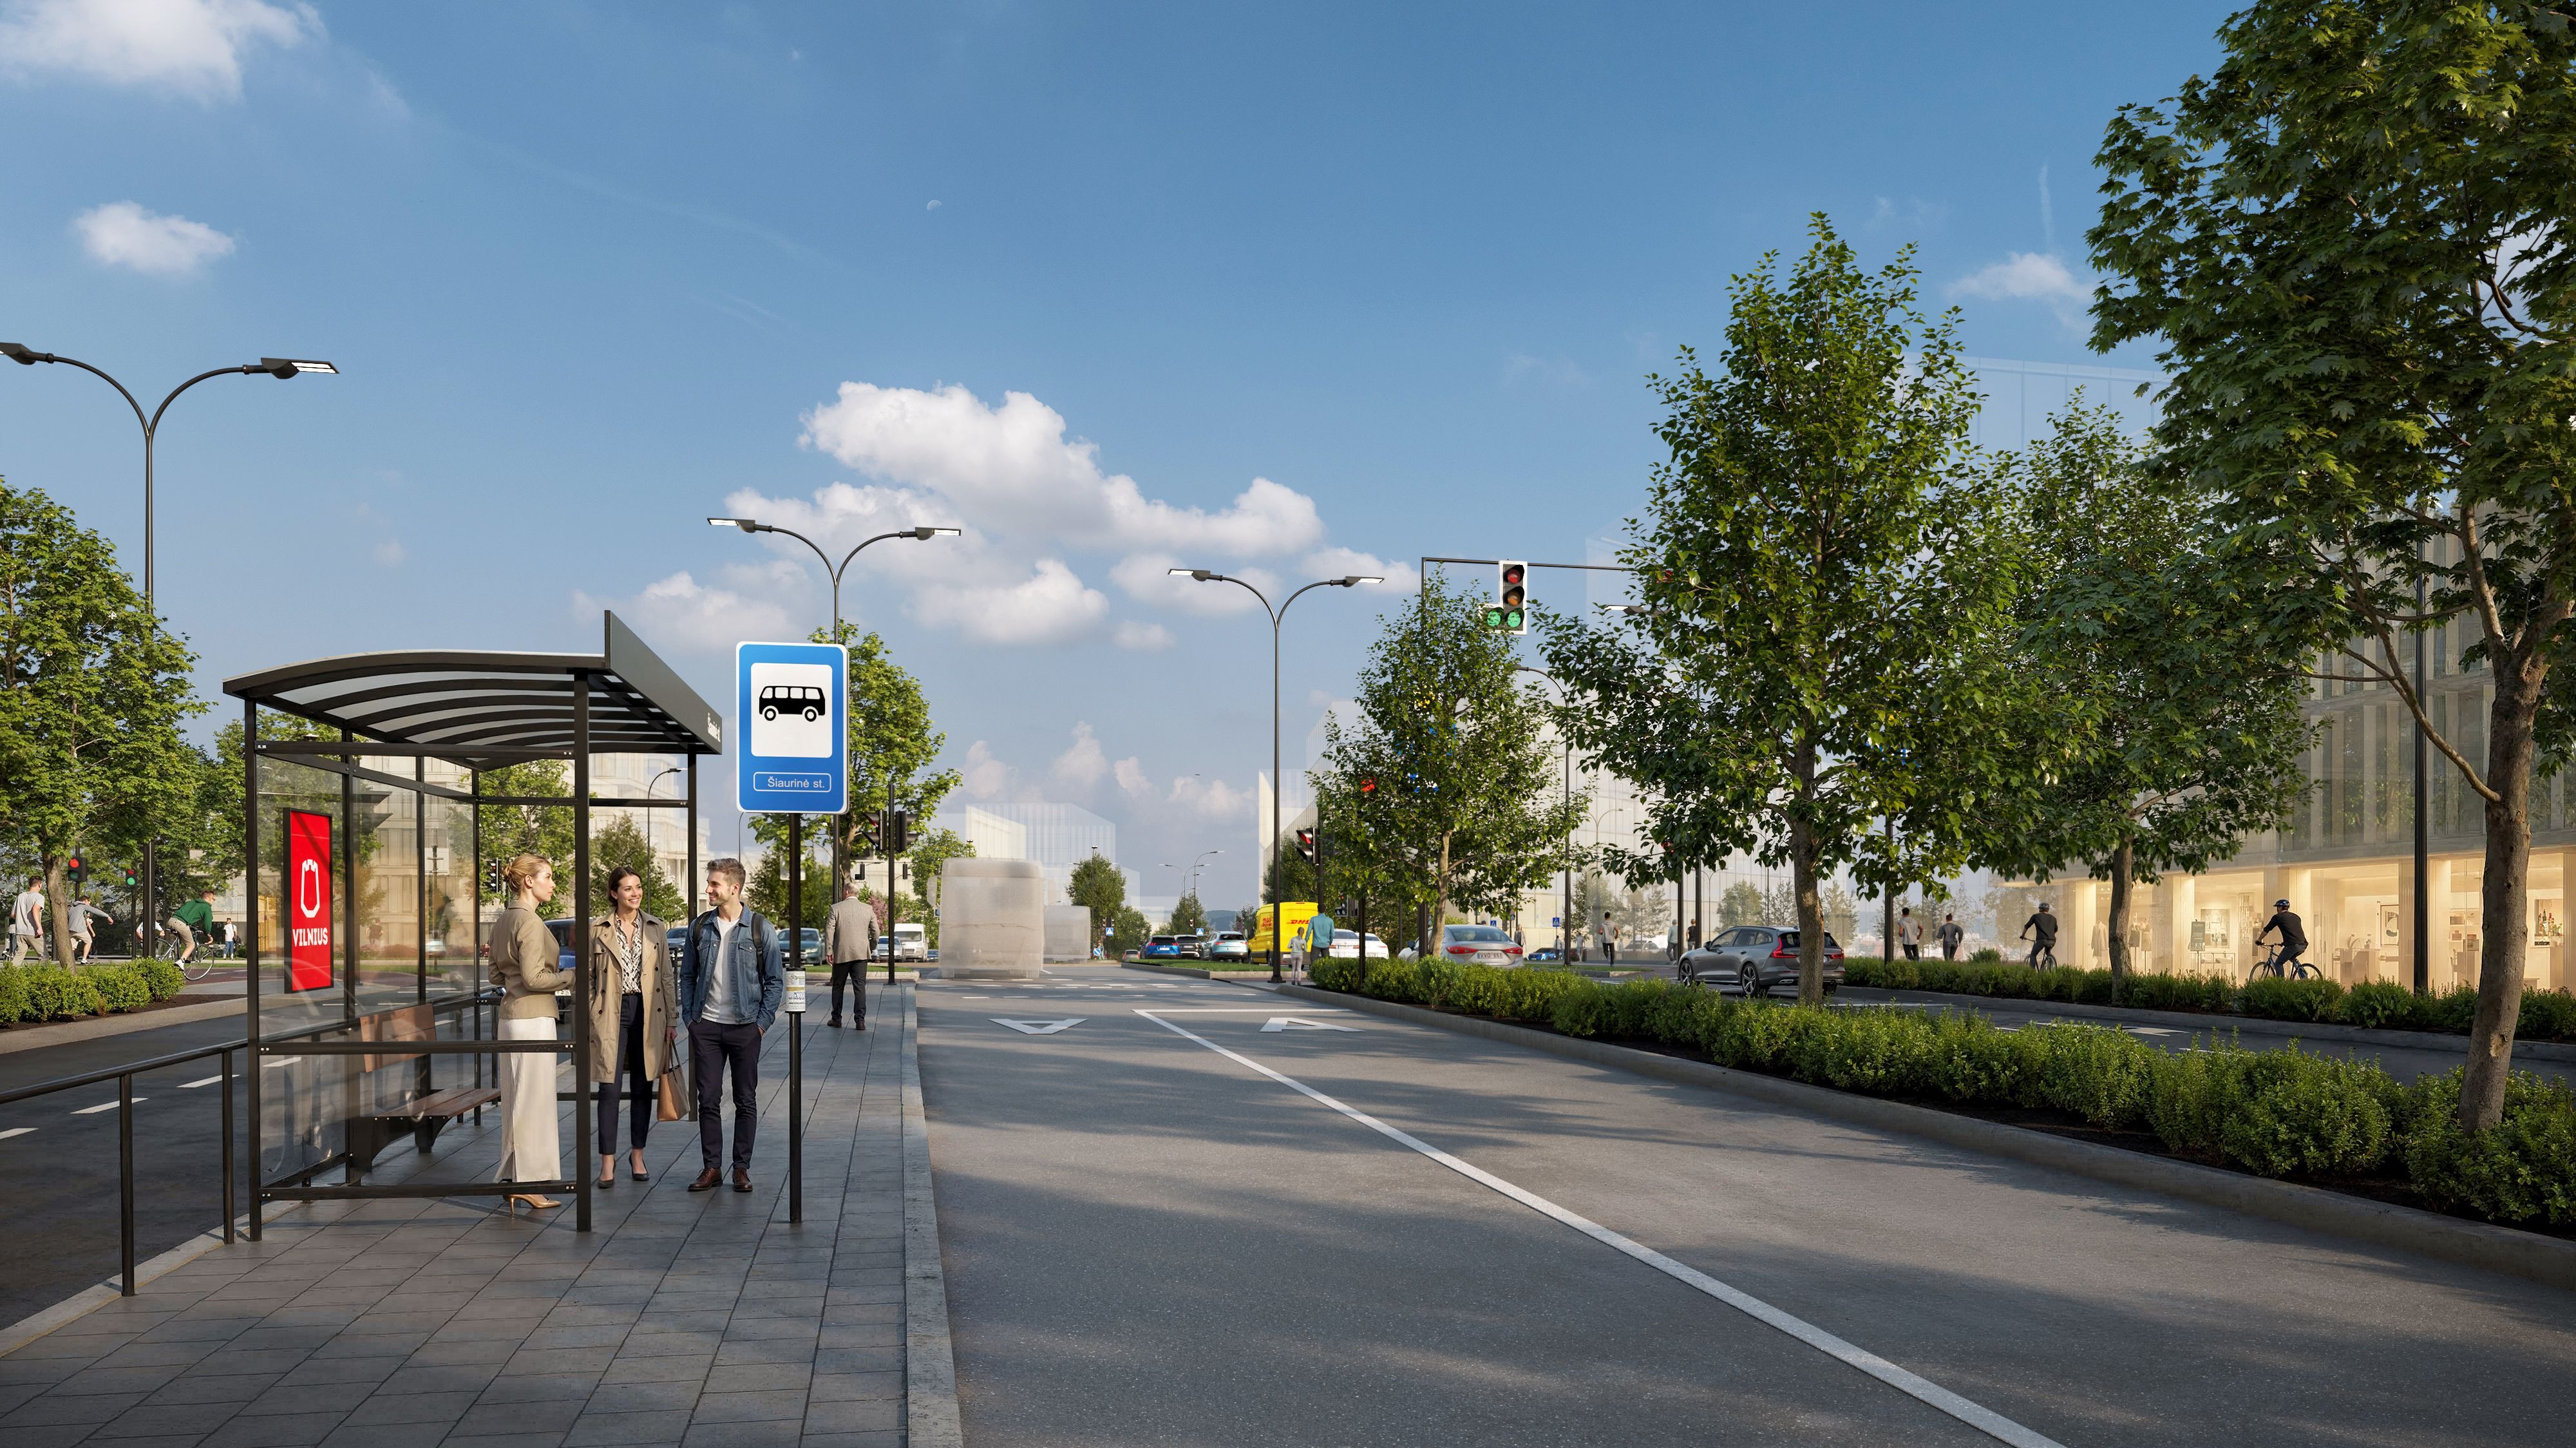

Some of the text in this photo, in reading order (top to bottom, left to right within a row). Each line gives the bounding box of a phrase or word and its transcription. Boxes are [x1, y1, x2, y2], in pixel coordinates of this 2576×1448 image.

[768, 776, 825, 788] Šiaurinė st.
[292, 928, 328, 947] VILNIUS
